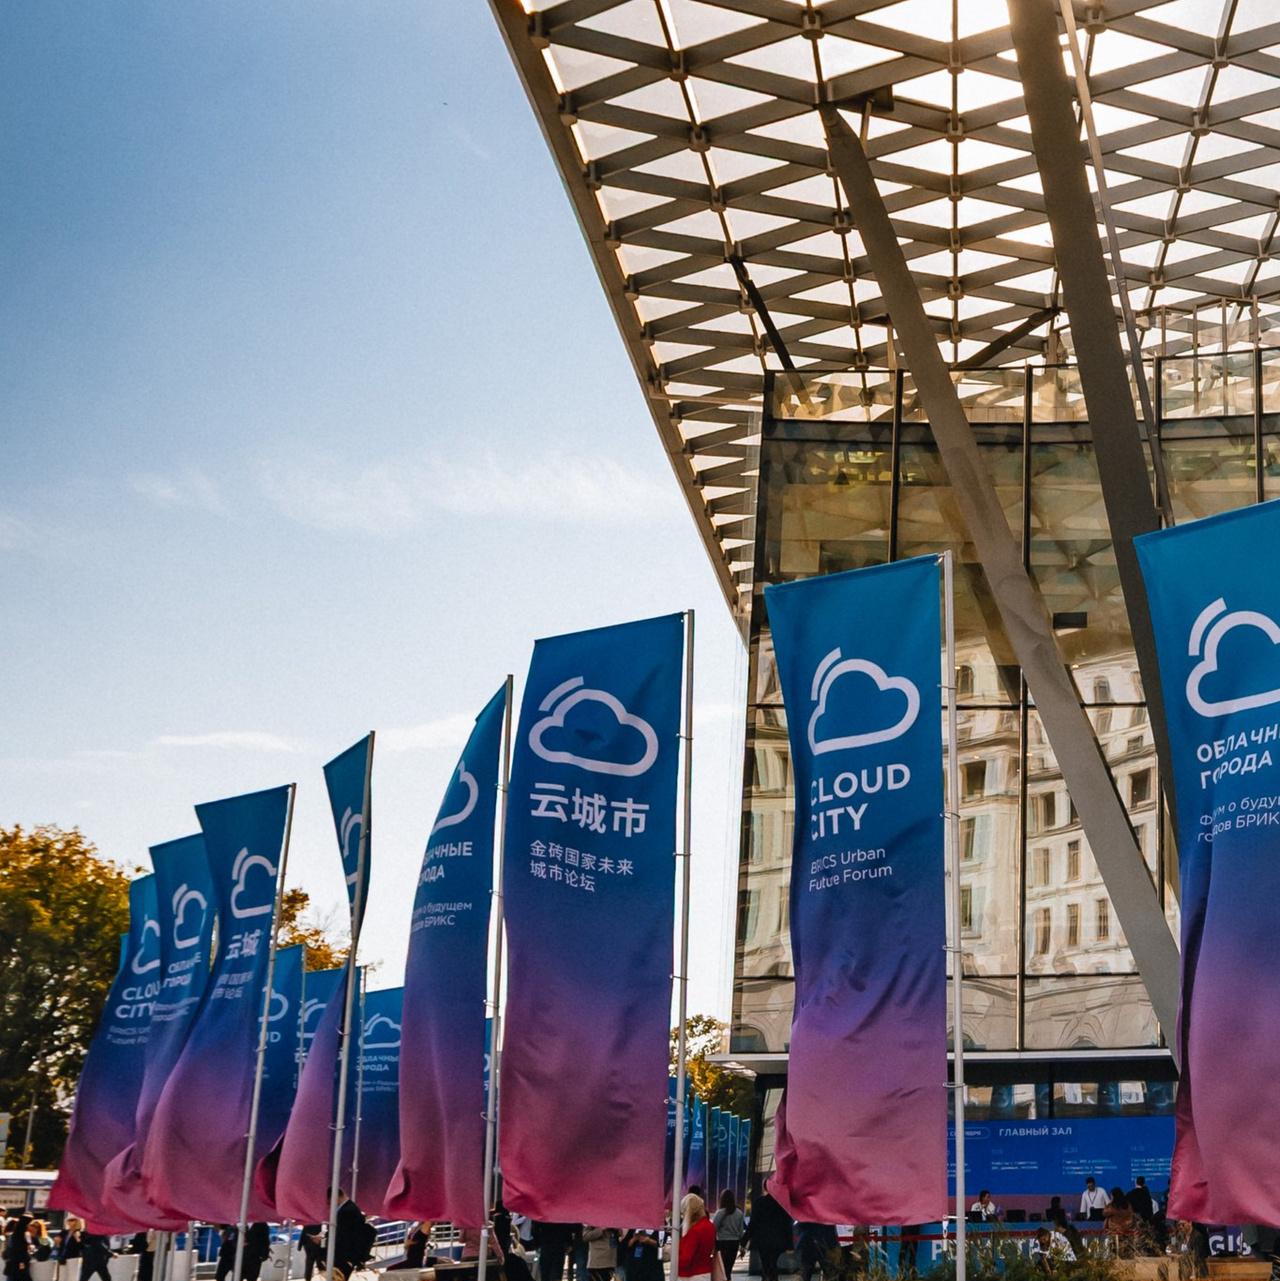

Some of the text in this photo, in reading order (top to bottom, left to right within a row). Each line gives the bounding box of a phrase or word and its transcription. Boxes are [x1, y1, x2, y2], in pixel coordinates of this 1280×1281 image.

[811, 763, 911, 807] CLOUD
[530, 782, 650, 838] 云城市
[1228, 801, 1237, 812] о
[811, 803, 869, 841] CITY
[530, 839, 634, 876] 金砖国家未来
[840, 848, 886, 865] Urban
[530, 859, 597, 893] 城市论坛
[809, 865, 893, 892] Future Forum
[225, 929, 262, 960] 云城
[121, 980, 160, 1001] CLOU
[115, 1000, 157, 1019] CITY
[998, 1125, 1073, 1137] ГЛАВНЫЙ ЗАЛ
